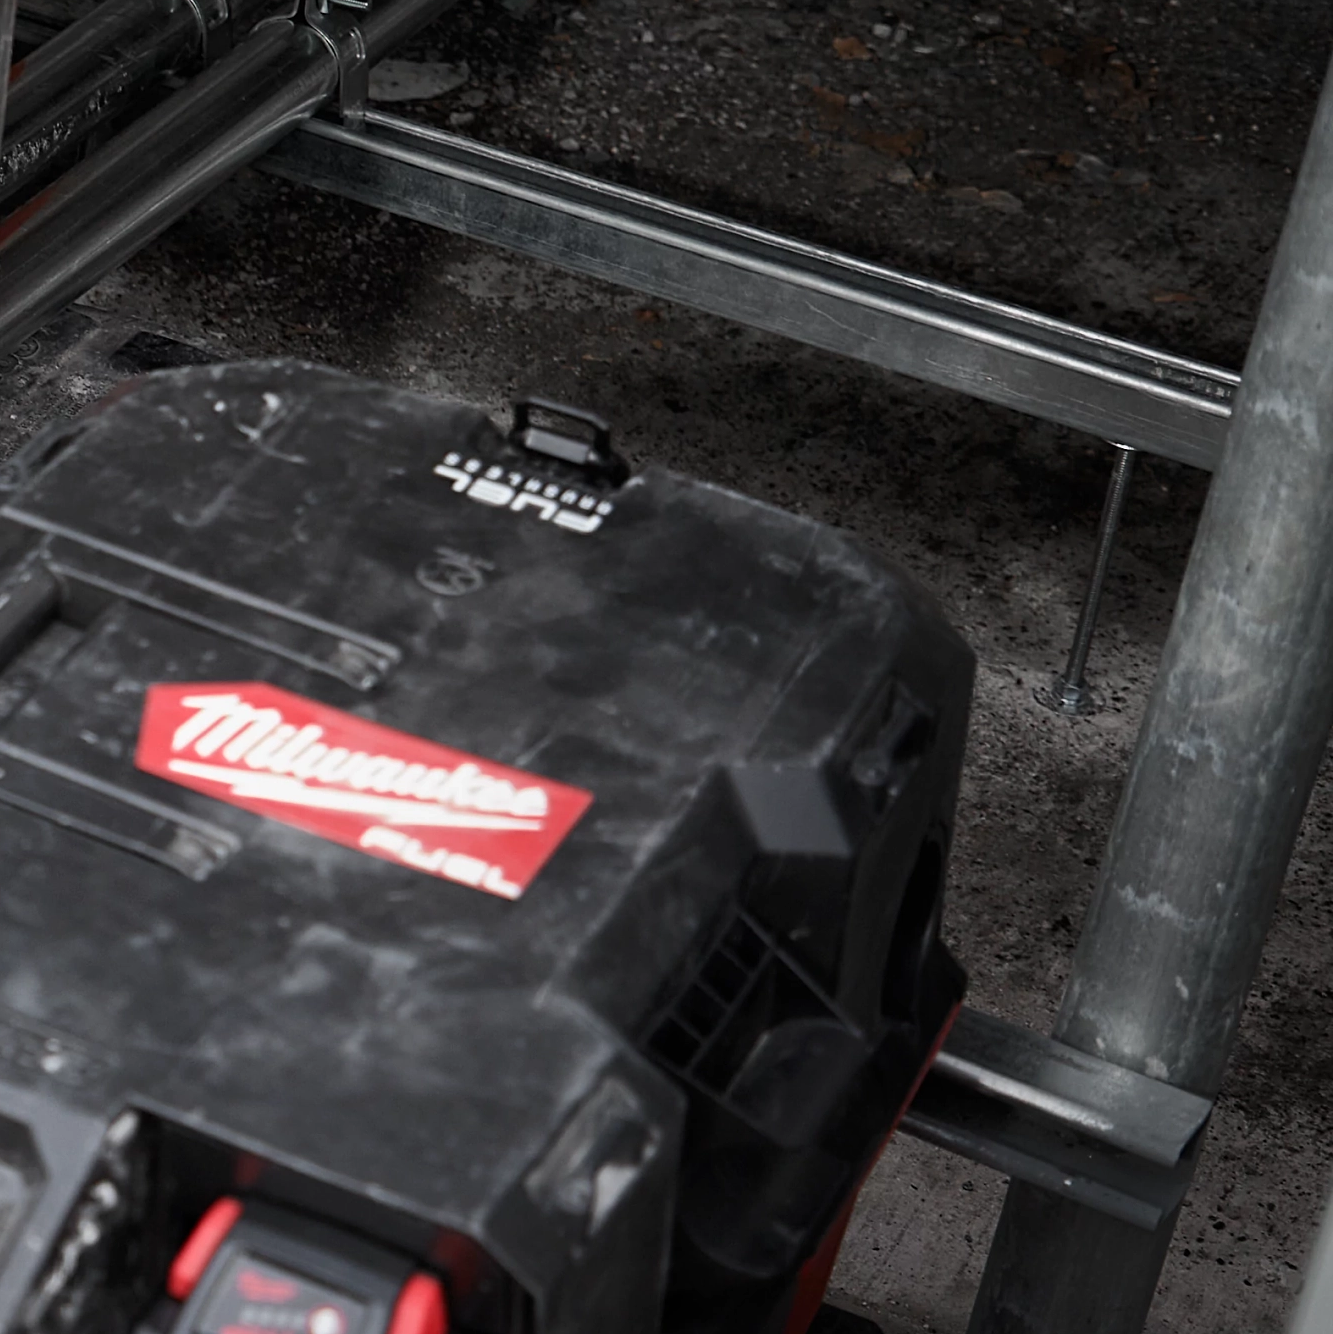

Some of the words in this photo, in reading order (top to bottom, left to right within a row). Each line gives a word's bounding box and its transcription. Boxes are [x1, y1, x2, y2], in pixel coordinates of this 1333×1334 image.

[433, 464, 602, 533] FUEL
[172, 694, 548, 817] Milwaukee
[359, 825, 521, 899] FUEL
